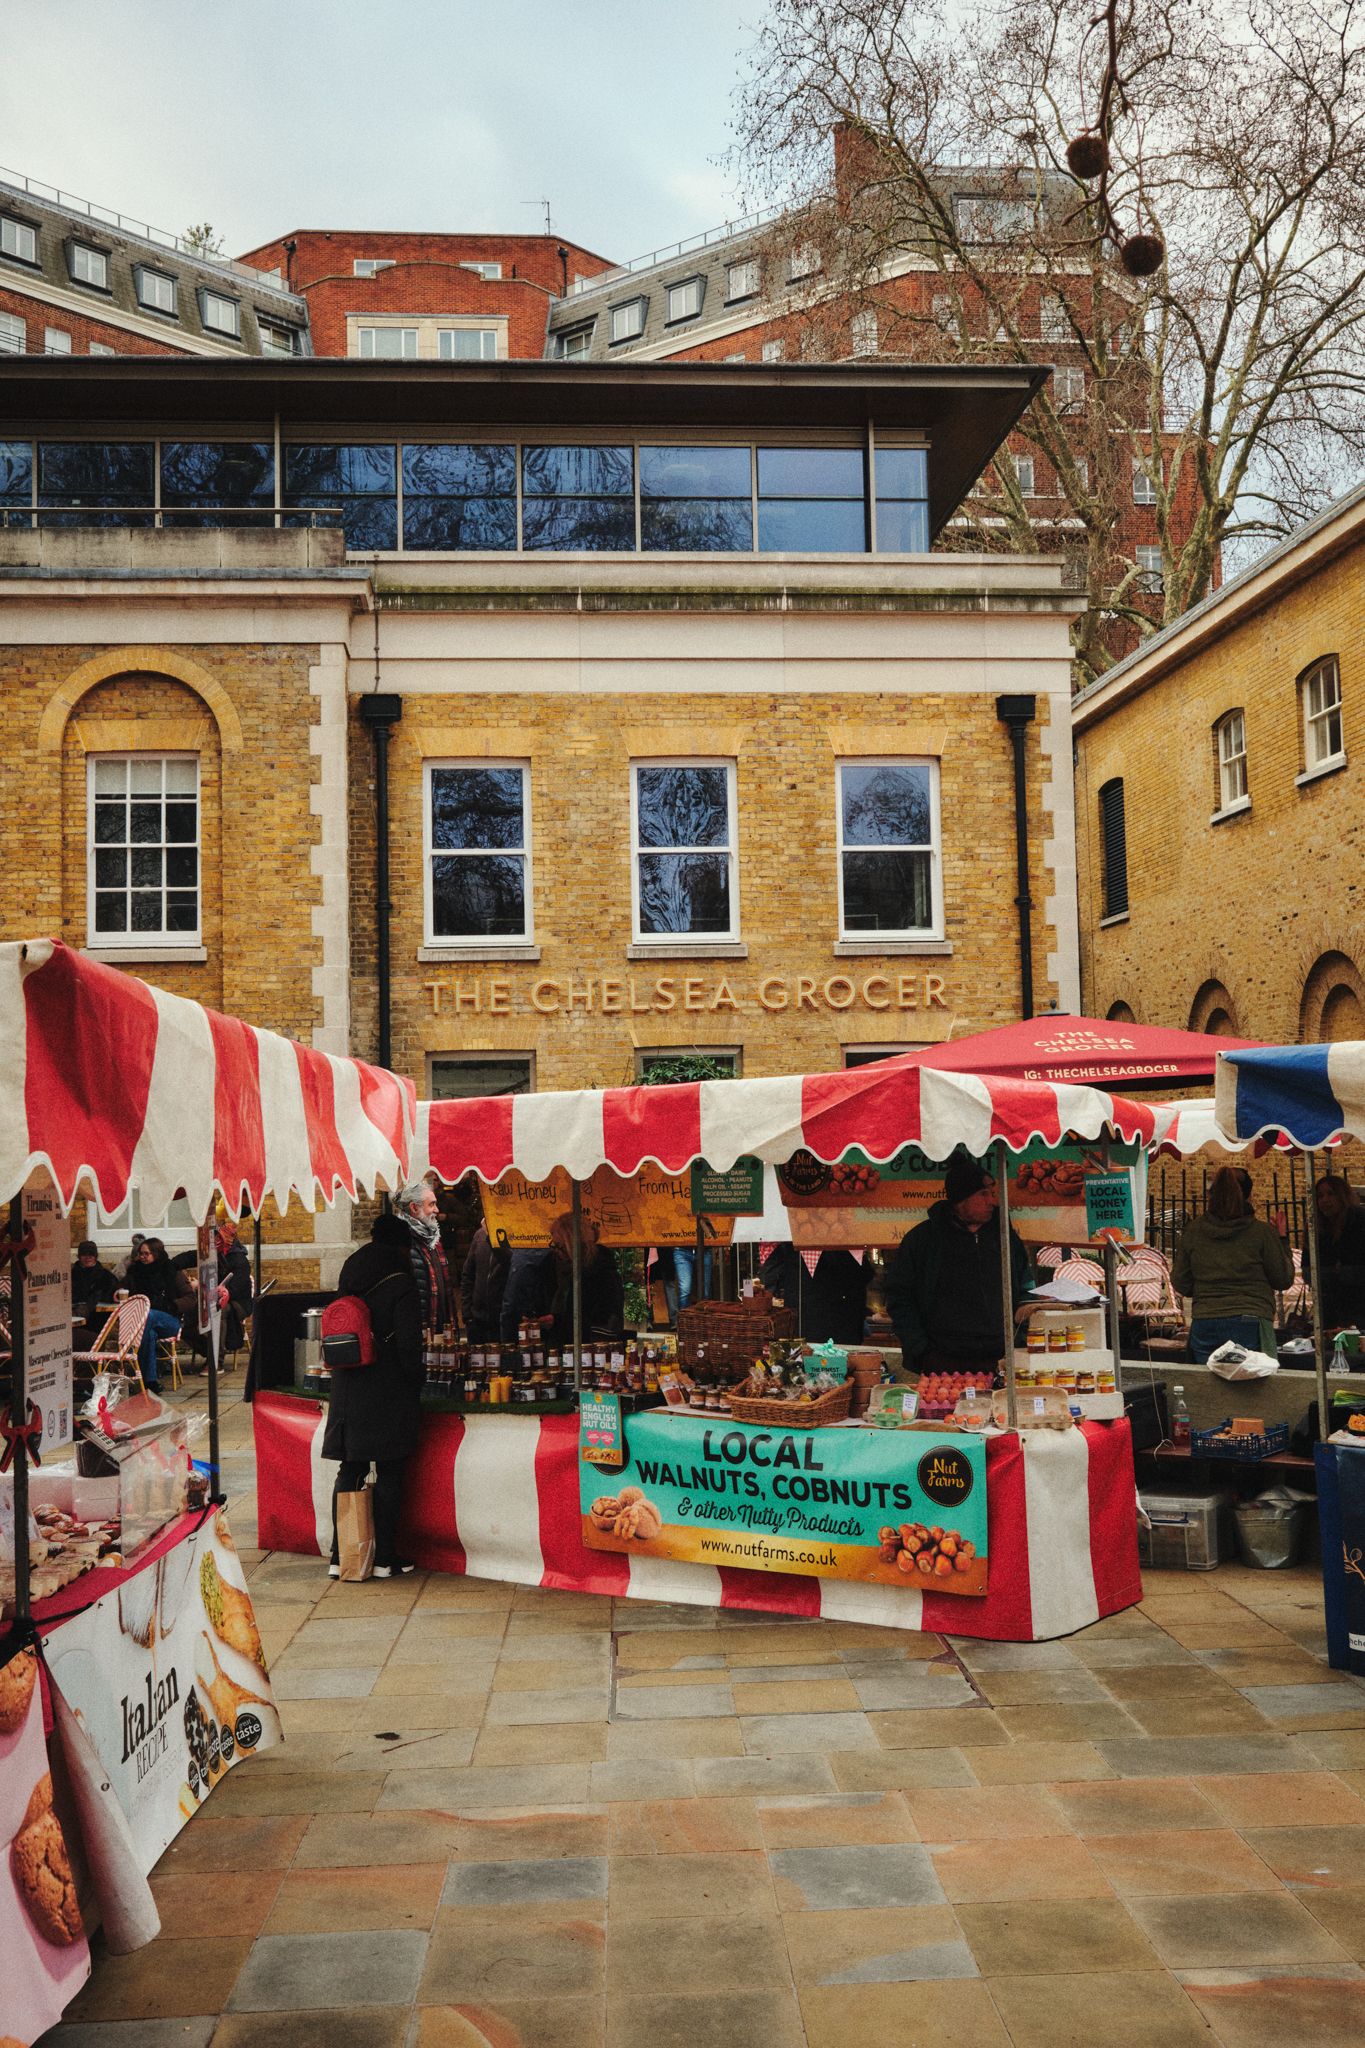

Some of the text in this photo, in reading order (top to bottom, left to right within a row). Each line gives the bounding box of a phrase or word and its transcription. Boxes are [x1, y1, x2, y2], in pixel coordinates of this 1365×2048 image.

[424, 974, 948, 1014] THE CHELSEA GROCER
[1033, 1038, 1135, 1047] CHELSEA
[1044, 1044, 1136, 1053] GROCER
[1024, 1064, 1179, 1080] IG: THECHELSEAGROCER
[517, 1182, 556, 1204] Honey
[638, 1176, 669, 1194] From
[1090, 1187, 1127, 1197] LOCAL
[1090, 1198, 1128, 1208] HONEY
[1095, 1210, 1124, 1220] HERE
[582, 1403, 616, 1414] HEALTHY
[582, 1412, 616, 1422] ENGLISH
[582, 1420, 617, 1430] NUT OILS
[702, 1430, 824, 1472] LOCAL
[934, 1457, 958, 1476] Nut
[635, 1459, 912, 1510] WALNUTS, COBNUTS
[927, 1468, 966, 1489] Farms
[677, 1496, 865, 1537] & other Nutty Products
[700, 1539, 838, 1567] www.nutfarms.co.uk
[120, 1667, 179, 1765] Italian
[236, 1723, 261, 1741] taste
[136, 1721, 169, 1785] RECIPE
